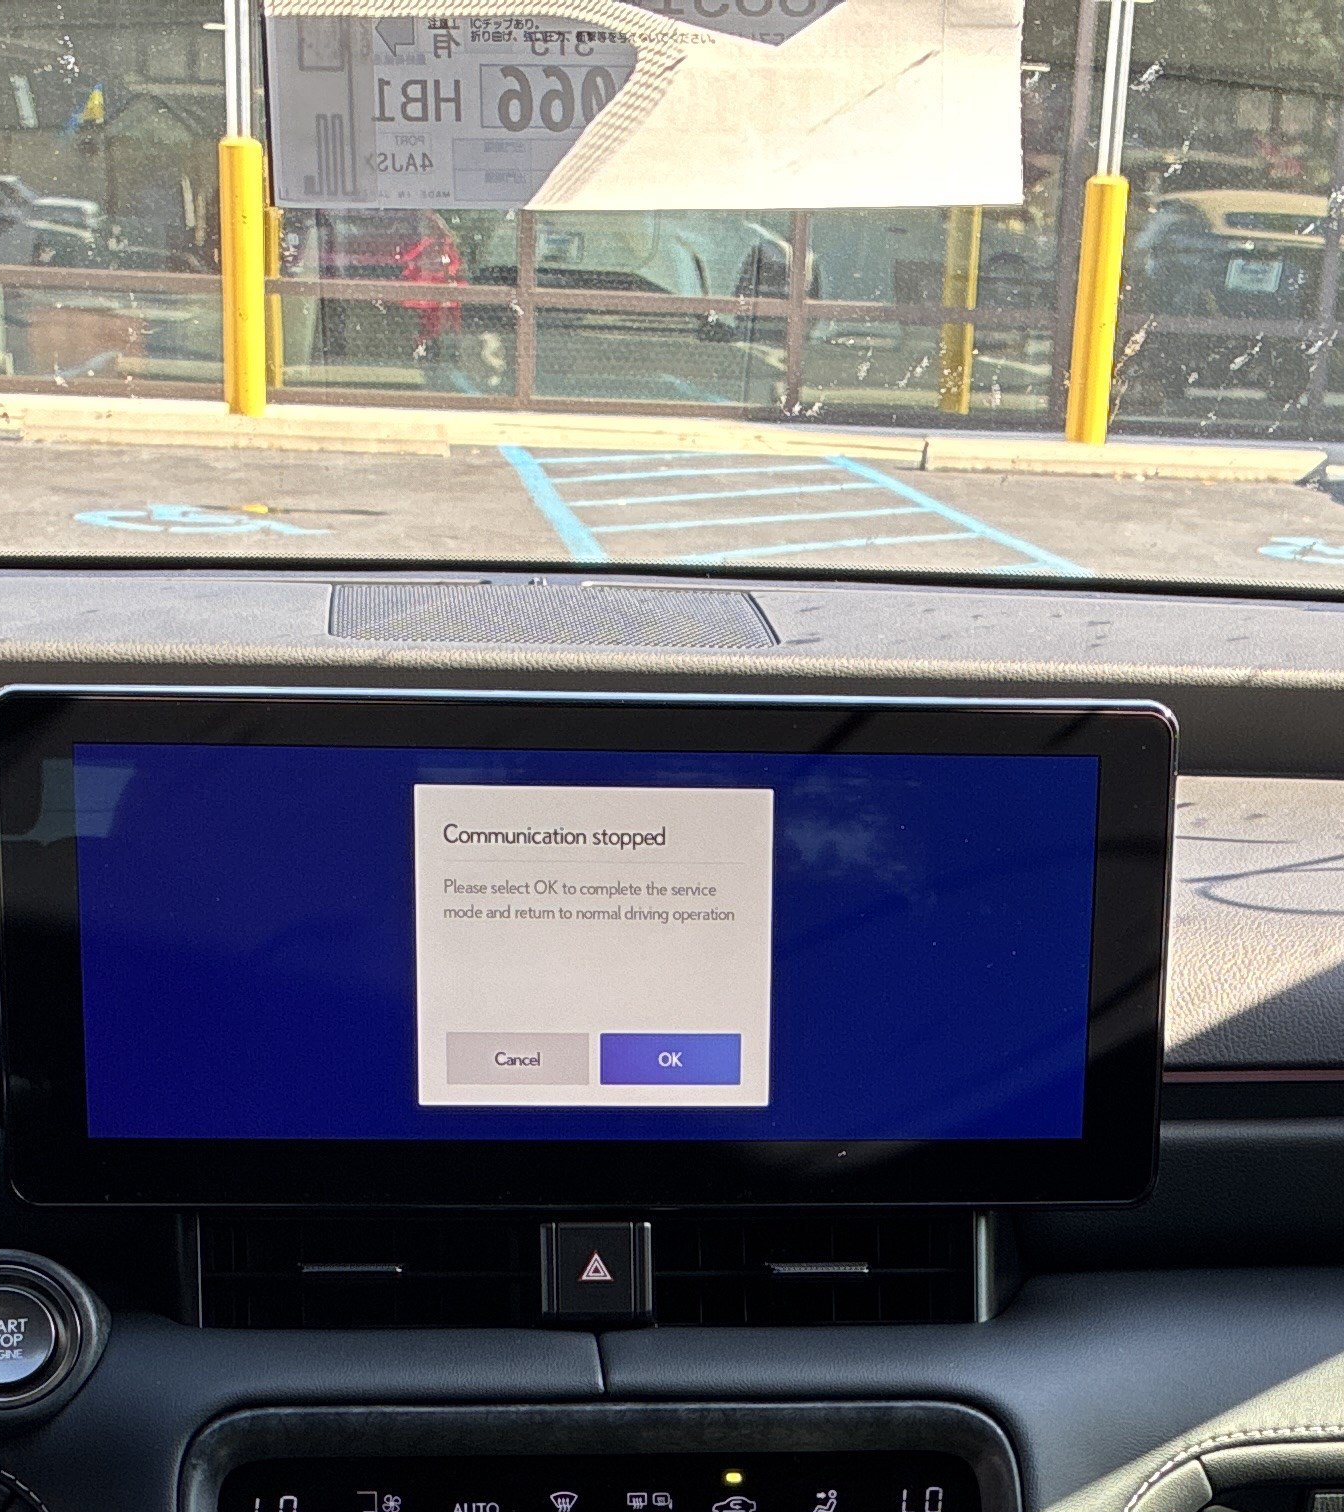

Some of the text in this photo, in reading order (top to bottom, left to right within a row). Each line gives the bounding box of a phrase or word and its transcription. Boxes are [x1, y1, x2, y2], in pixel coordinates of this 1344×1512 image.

[443, 823, 666, 850] Communication stopped
[443, 879, 717, 900] Please select OK to complete the service
[443, 906, 735, 924] mode and return to normal driving operation
[494, 1051, 541, 1067] Cancel
[657, 1052, 683, 1068] OK
